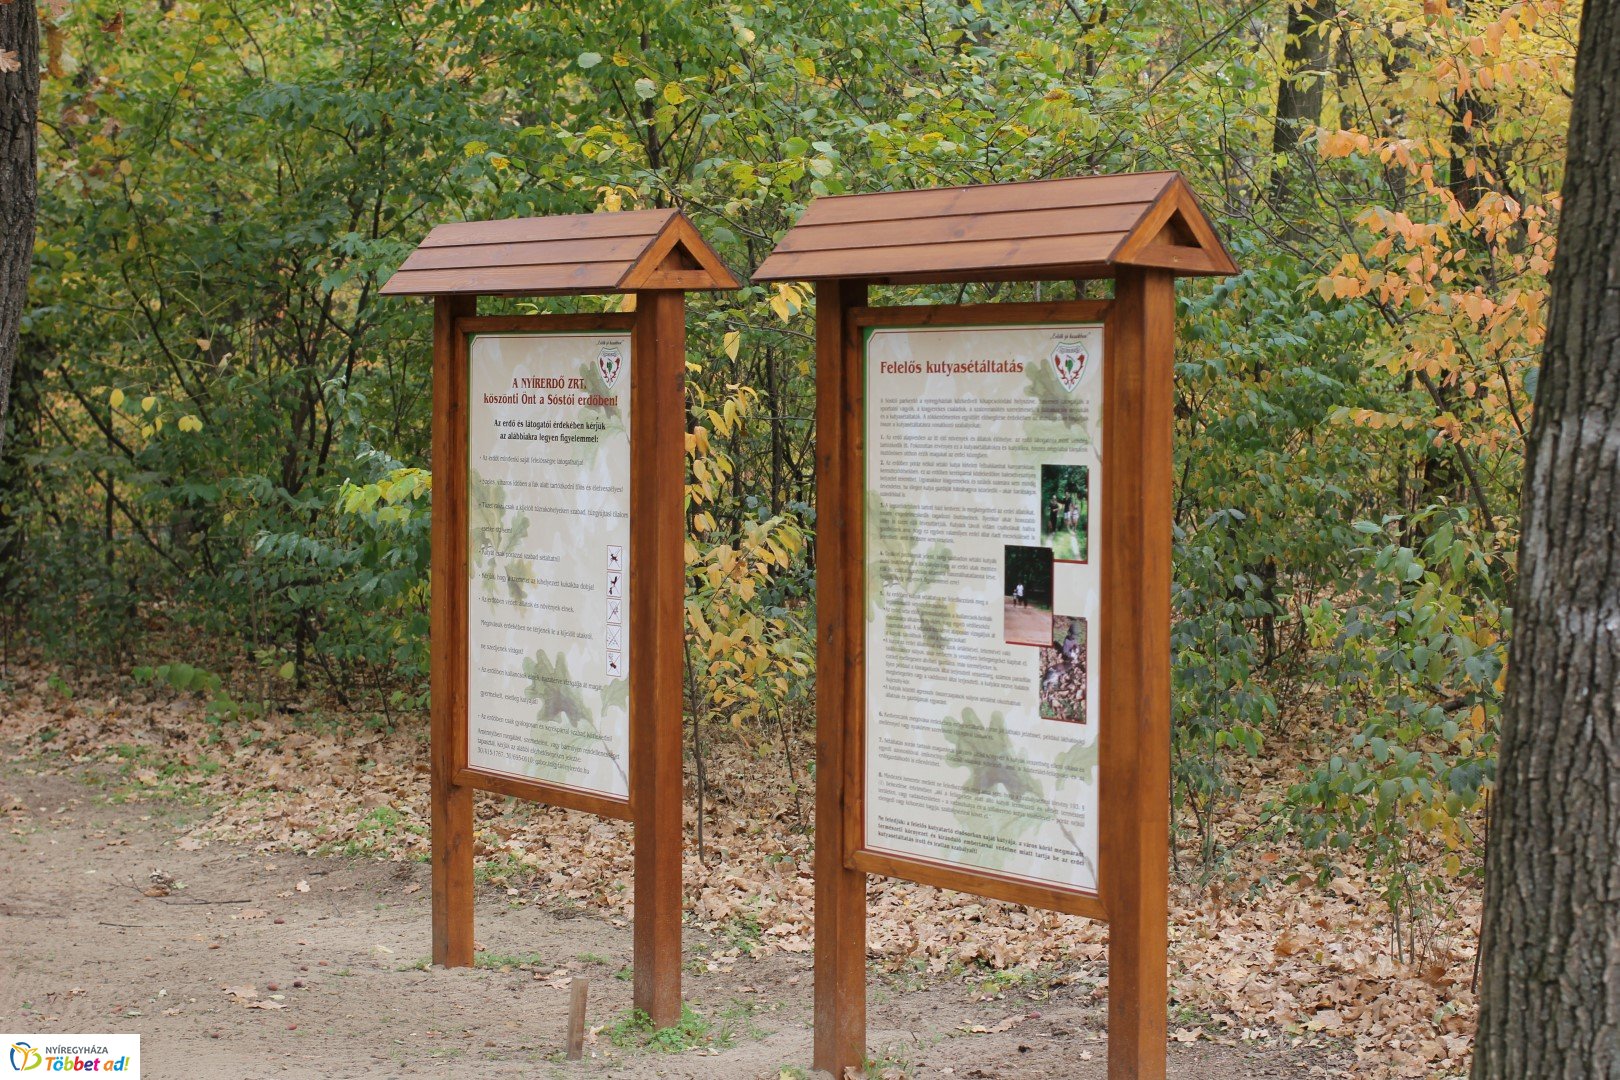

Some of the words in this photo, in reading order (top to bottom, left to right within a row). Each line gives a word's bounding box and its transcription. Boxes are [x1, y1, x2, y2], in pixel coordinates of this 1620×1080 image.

[880, 360, 922, 374] Felelős
[926, 358, 1024, 376] kutyasétáltatás
[512, 378, 518, 388] A
[522, 375, 564, 388] NYÍRERDŐ
[568, 378, 587, 389] ZRT.
[483, 393, 519, 405] köszönti
[522, 391, 536, 405] Önt
[540, 397, 544, 405] a
[548, 394, 574, 405] Sóstói
[578, 395, 618, 406] erdőben!
